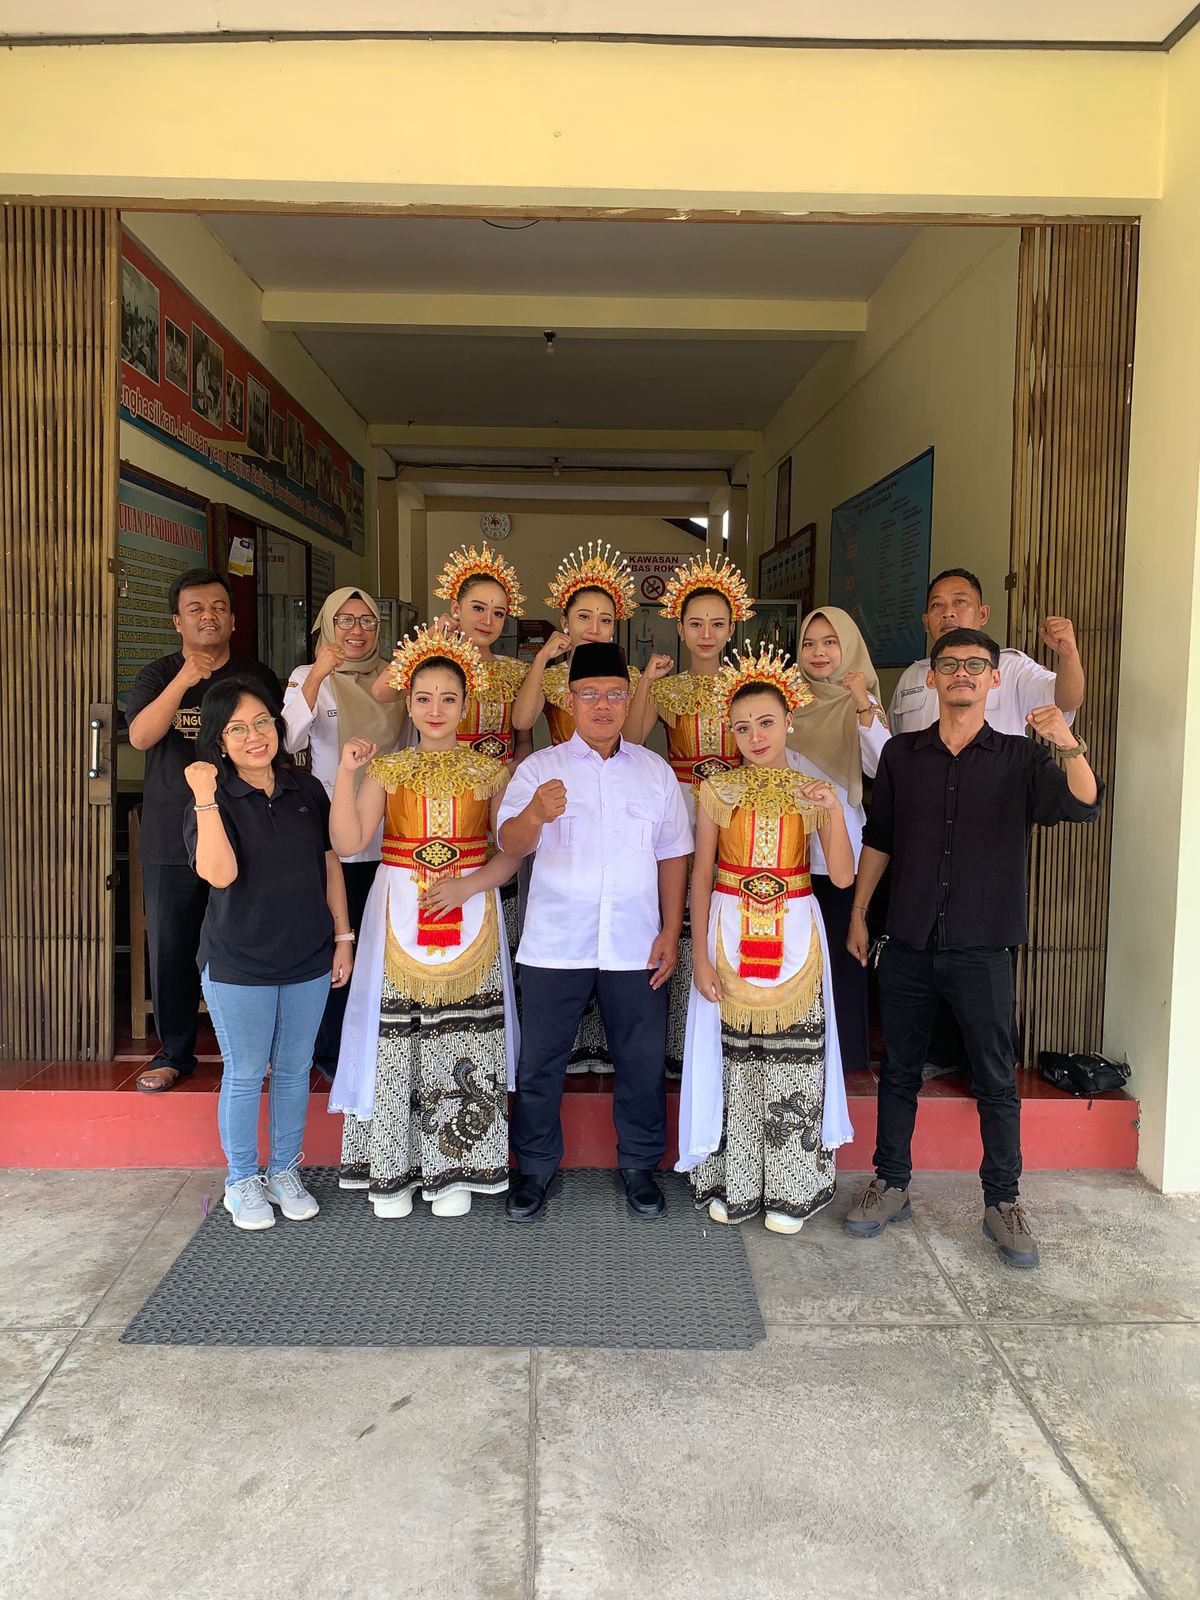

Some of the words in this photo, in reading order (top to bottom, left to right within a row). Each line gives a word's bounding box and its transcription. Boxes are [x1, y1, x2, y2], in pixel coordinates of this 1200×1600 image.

[177, 414, 209, 457] Lulusan
[208, 444, 229, 472] yang
[144, 511, 190, 549] PENDIDIKAN
[629, 555, 679, 564] KAWASAN
